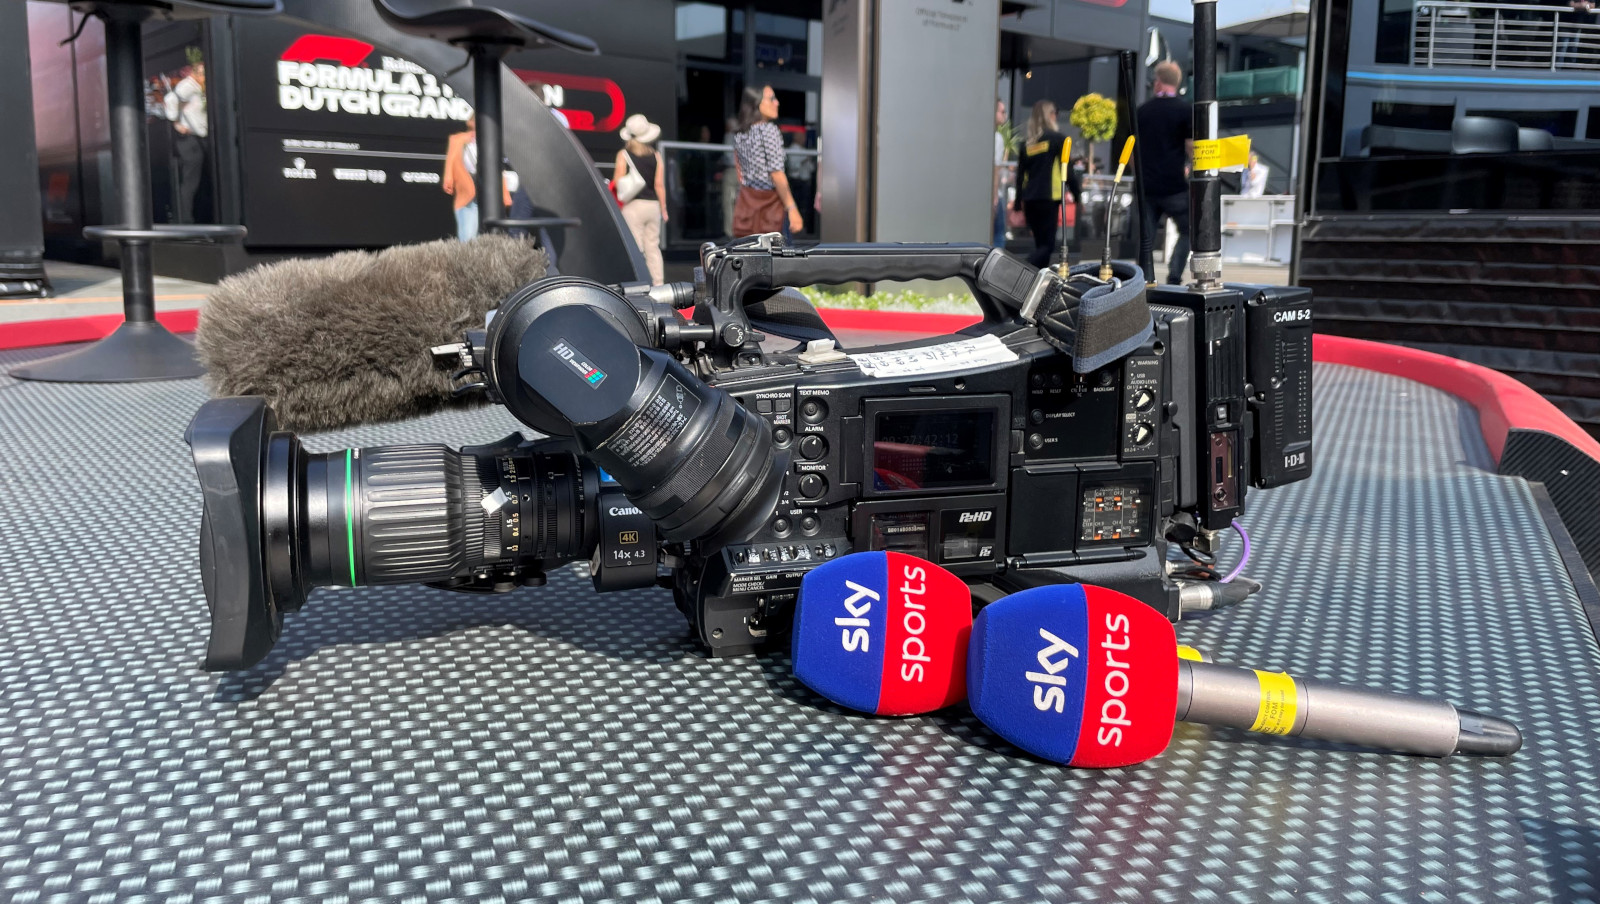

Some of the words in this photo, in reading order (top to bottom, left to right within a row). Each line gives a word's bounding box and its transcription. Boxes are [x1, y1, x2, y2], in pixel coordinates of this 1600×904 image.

[277, 60, 422, 96] FORMULA
[422, 73, 441, 97] 1
[279, 84, 381, 116] DUTCH
[381, 94, 474, 120] GRAND
[1274, 310, 1296, 322] CAM
[1297, 309, 1310, 320] 5-2
[552, 342, 574, 360] HD
[609, 506, 642, 516] Cano
[959, 511, 992, 522] P2HD
[622, 533, 635, 542] 4K
[634, 550, 645, 558] 4.3
[834, 580, 880, 652] sky
[900, 564, 931, 682] sports
[1025, 628, 1079, 714] sky
[1096, 612, 1132, 747] sports
